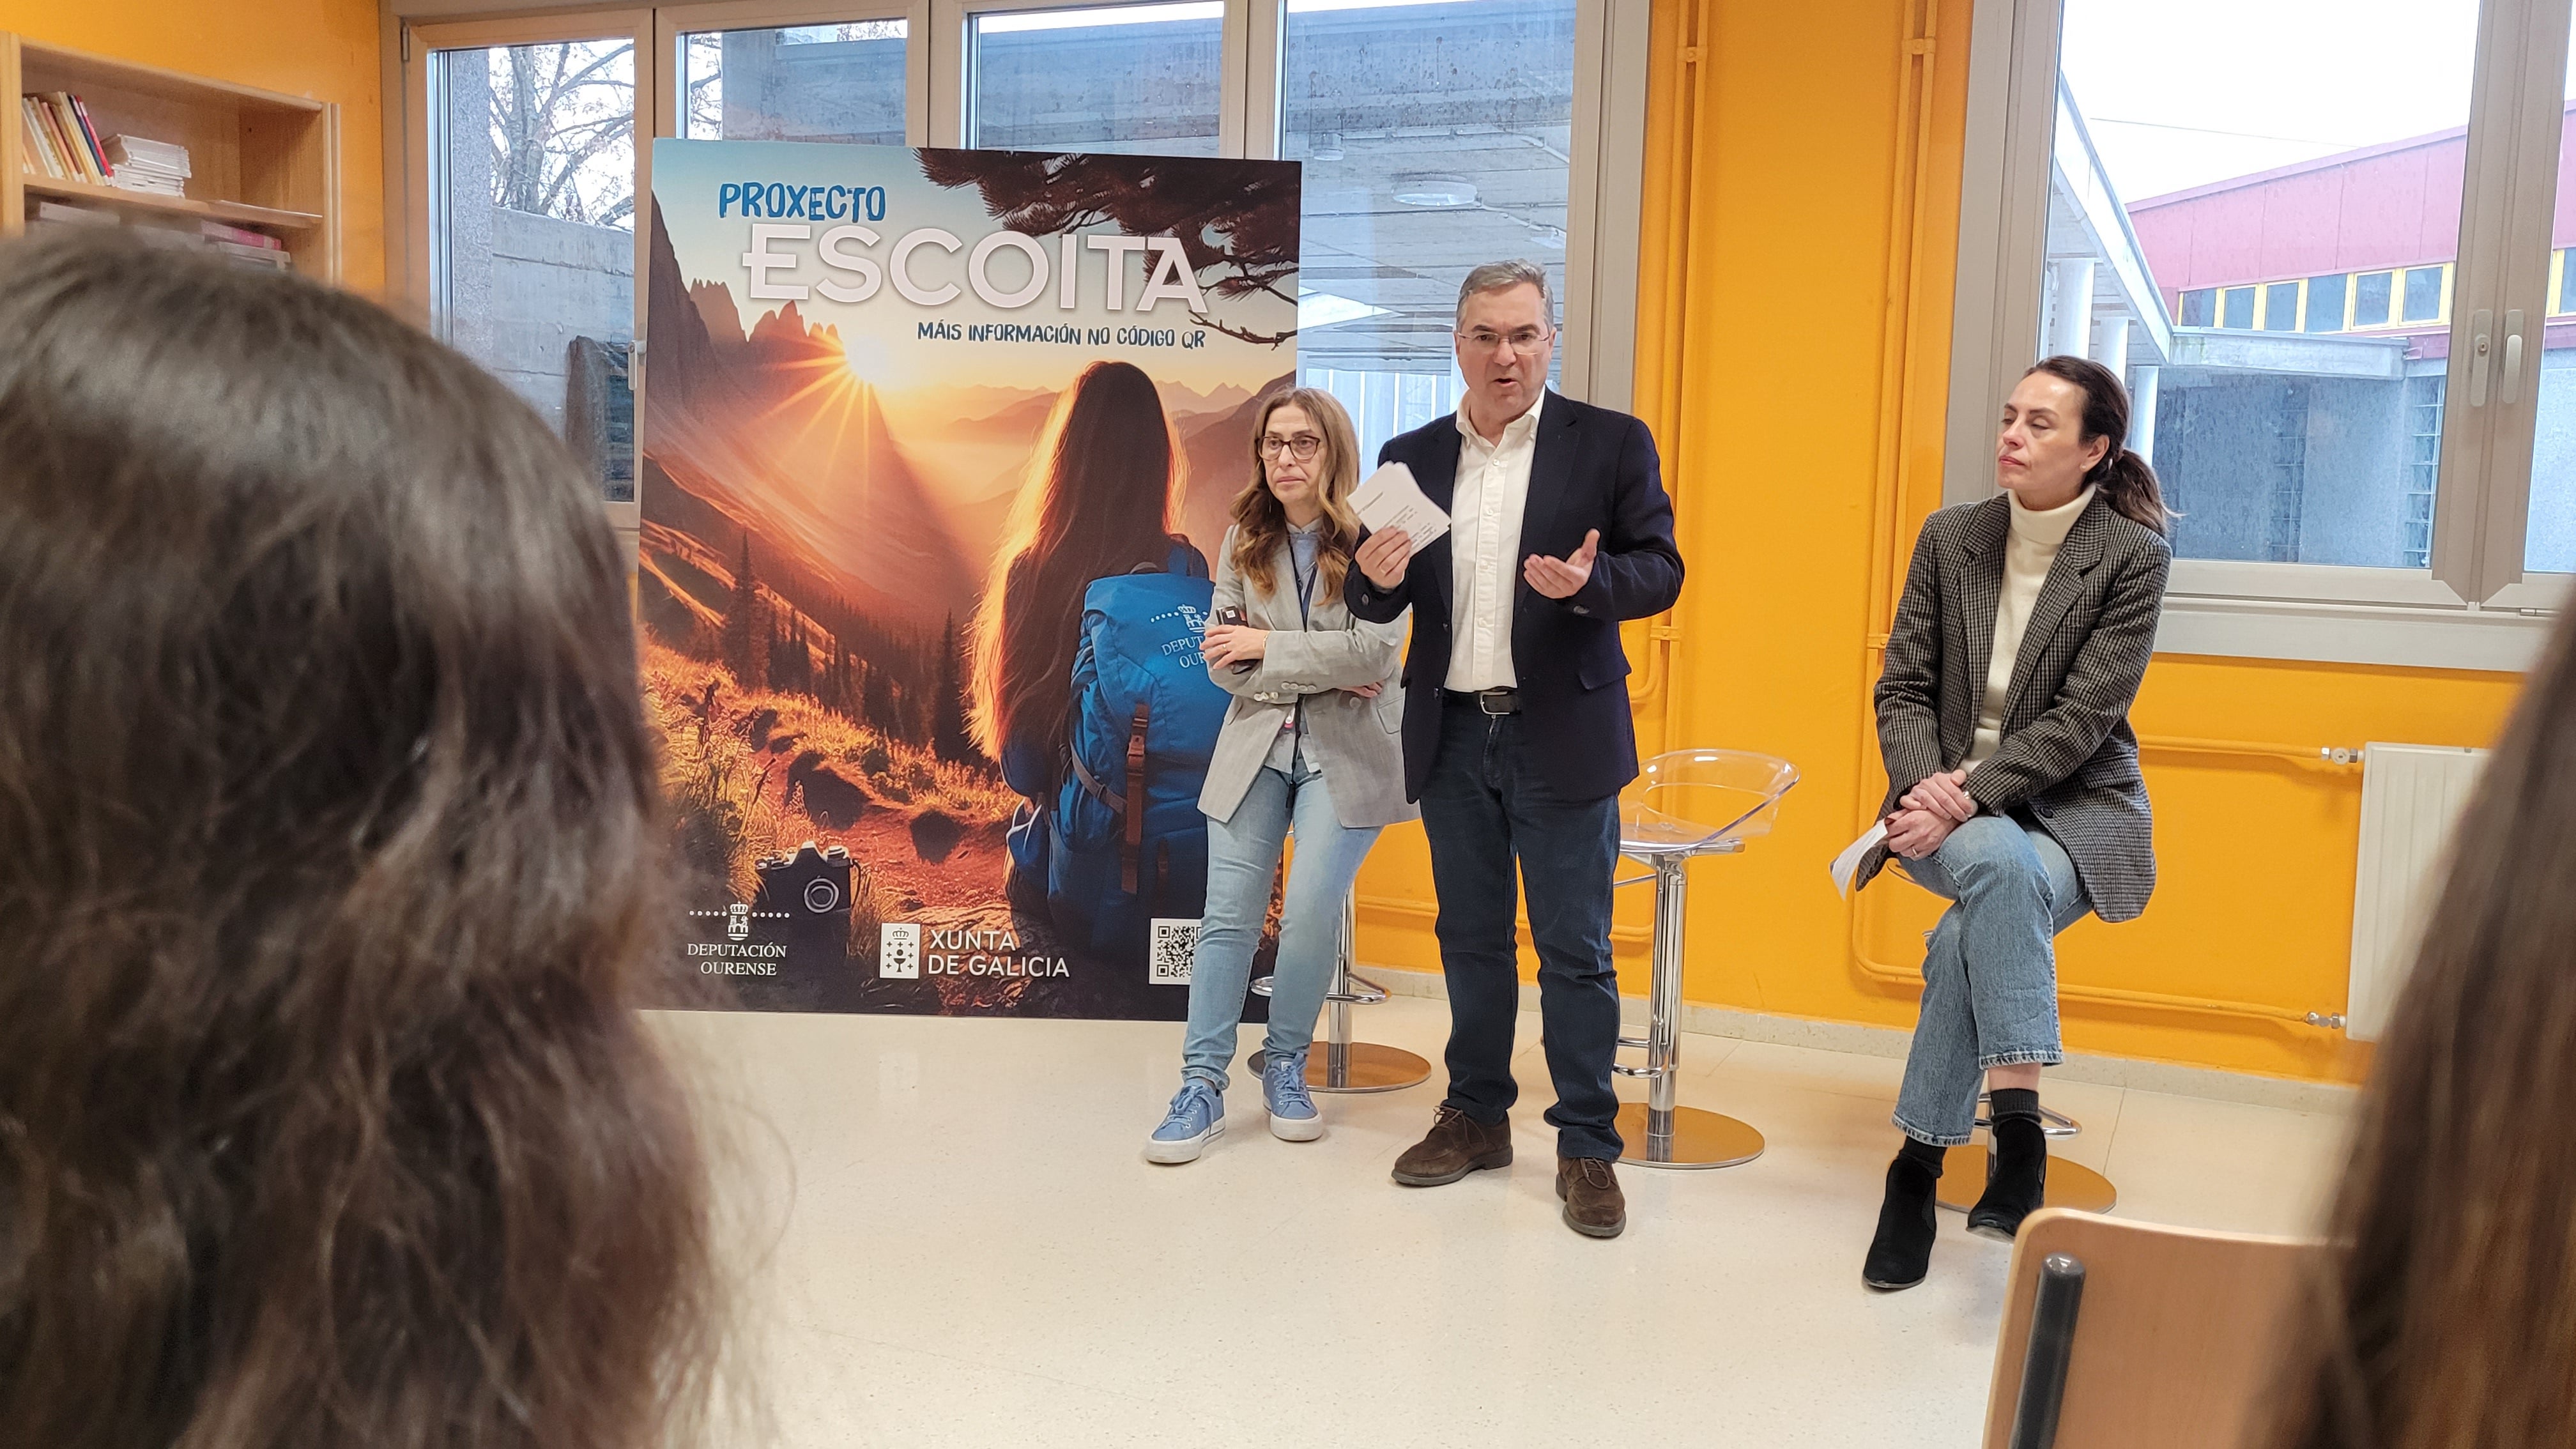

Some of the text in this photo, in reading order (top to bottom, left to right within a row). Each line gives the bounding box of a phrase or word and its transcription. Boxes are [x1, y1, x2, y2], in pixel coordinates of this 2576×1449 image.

[719, 181, 886, 223] PROXECTO
[742, 223, 1209, 314] ESCOITA
[917, 319, 1206, 349] MÁIS INFORMACIÓN NO CÓDIGO QR
[1161, 635, 1204, 656] DEPUT
[1179, 652, 1205, 668] OUR
[687, 941, 788, 958] DEPUTACIÓN
[929, 929, 1016, 951] XUNTA
[700, 961, 778, 976] OURENSE
[928, 954, 1070, 977] DE GALICIA
